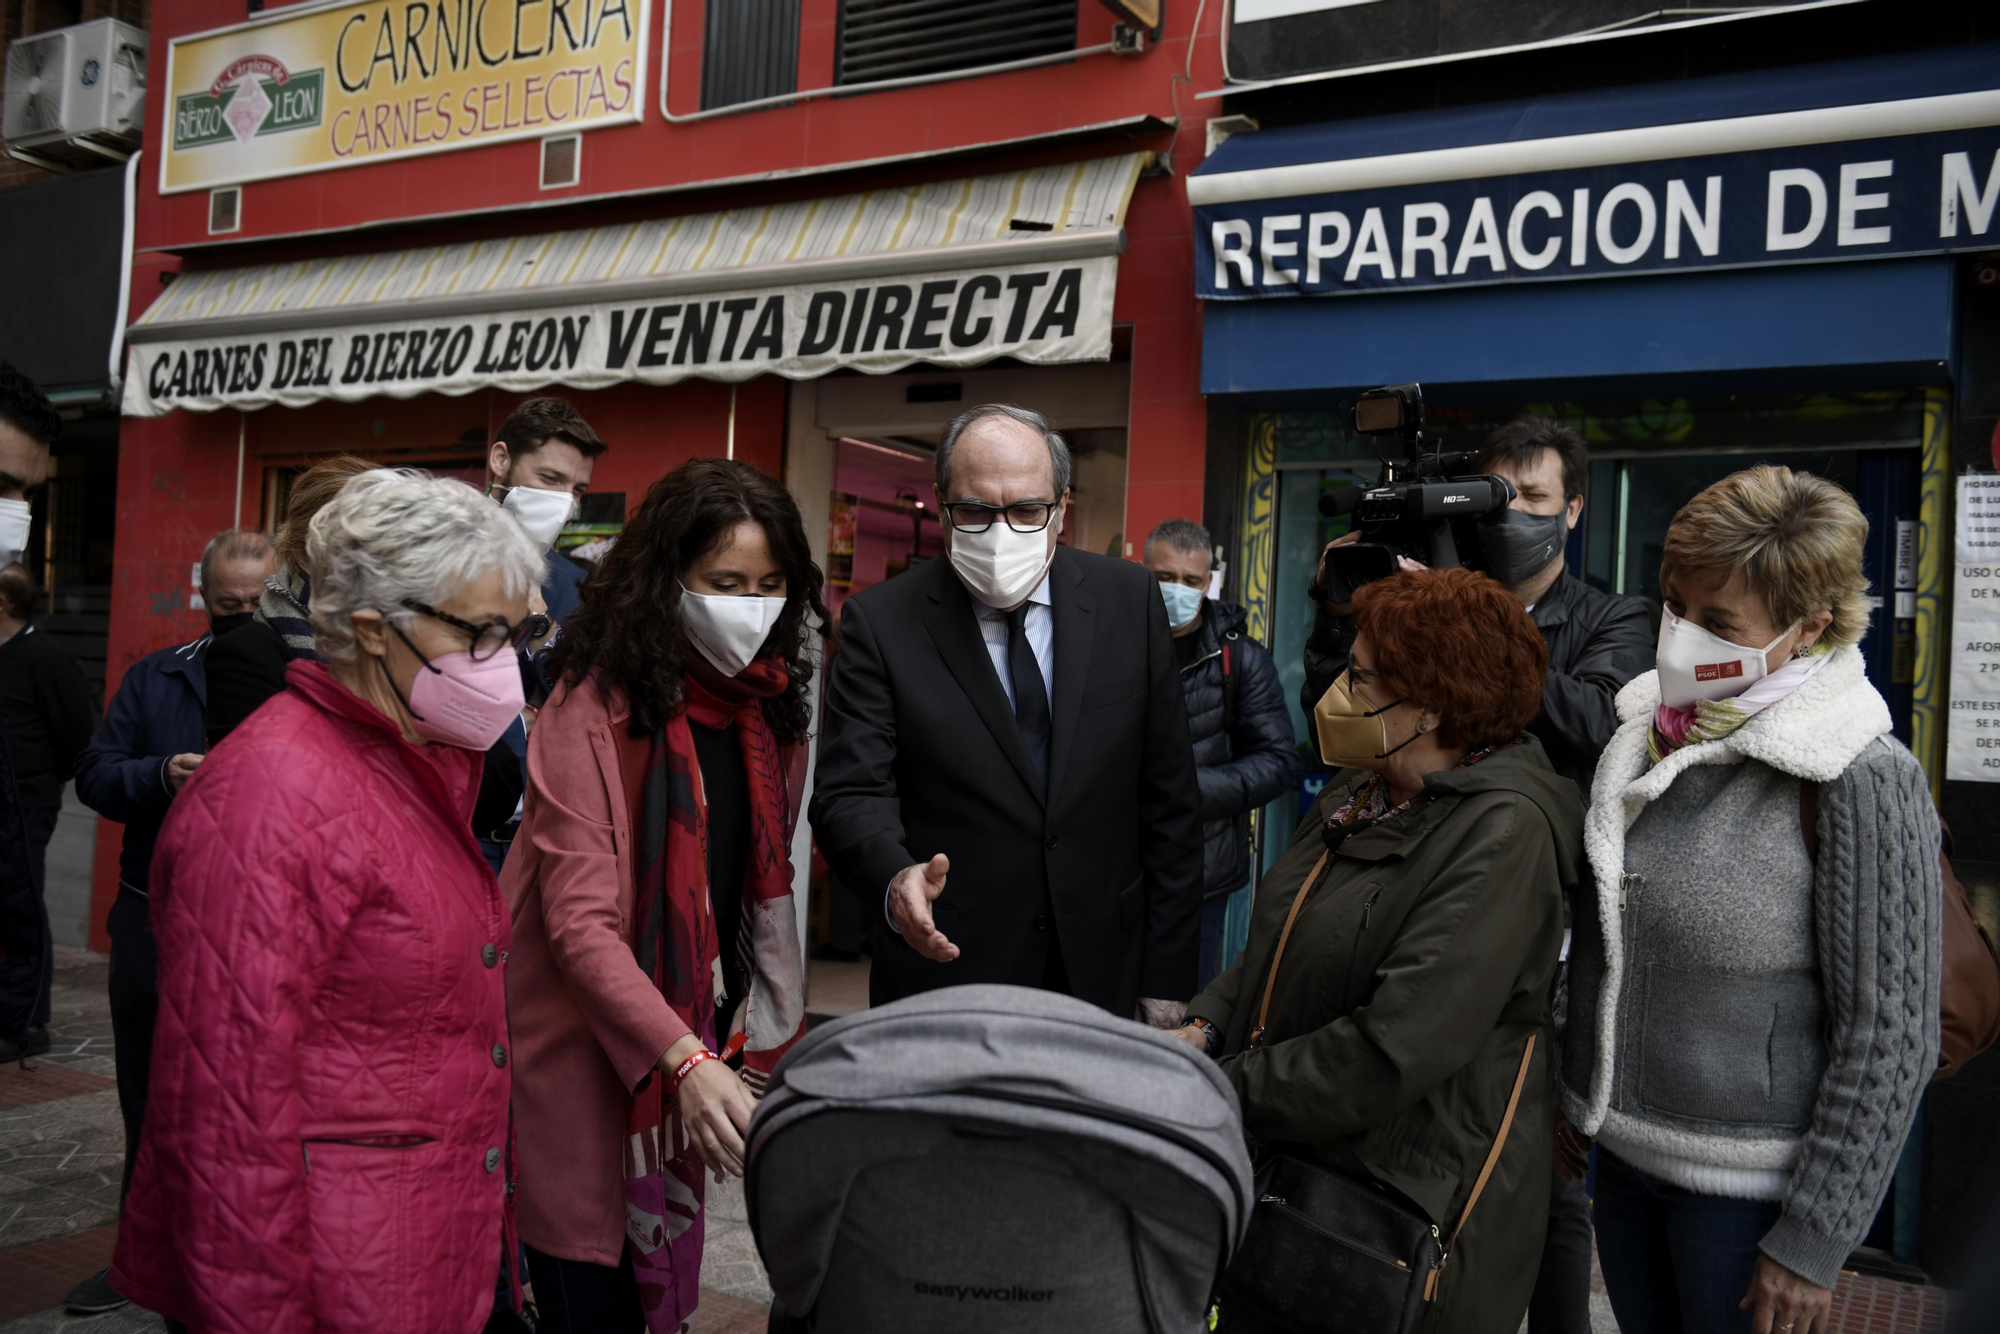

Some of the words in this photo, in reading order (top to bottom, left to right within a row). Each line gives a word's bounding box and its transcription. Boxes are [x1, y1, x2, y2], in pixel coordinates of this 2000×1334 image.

[331, 92, 452, 157] CARNES
[458, 60, 632, 137] SELECTAS
[177, 105, 222, 142] BIERZO
[274, 87, 316, 125] LEON
[1211, 175, 1722, 291] REPARACION
[1765, 159, 1893, 252] DE
[148, 341, 268, 400] CARNES
[271, 336, 334, 390] DEL
[340, 324, 474, 385] BIERZO
[474, 315, 591, 374] LEON
[605, 295, 786, 370] VENTA
[797, 267, 1083, 357] DIRECTA
[1443, 495, 1456, 504] HD
[1968, 496, 1982, 504] DE
[1898, 529, 1912, 571] TIMBRE
[1963, 567, 1990, 578] USO
[1971, 588, 1988, 598] DE
[1979, 663, 1987, 673] 2
[1697, 671, 1717, 679] PSOE
[1952, 701, 1979, 710] ESTE
[1976, 718, 1989, 728] SE
[914, 1281, 1056, 1301] easywalker
